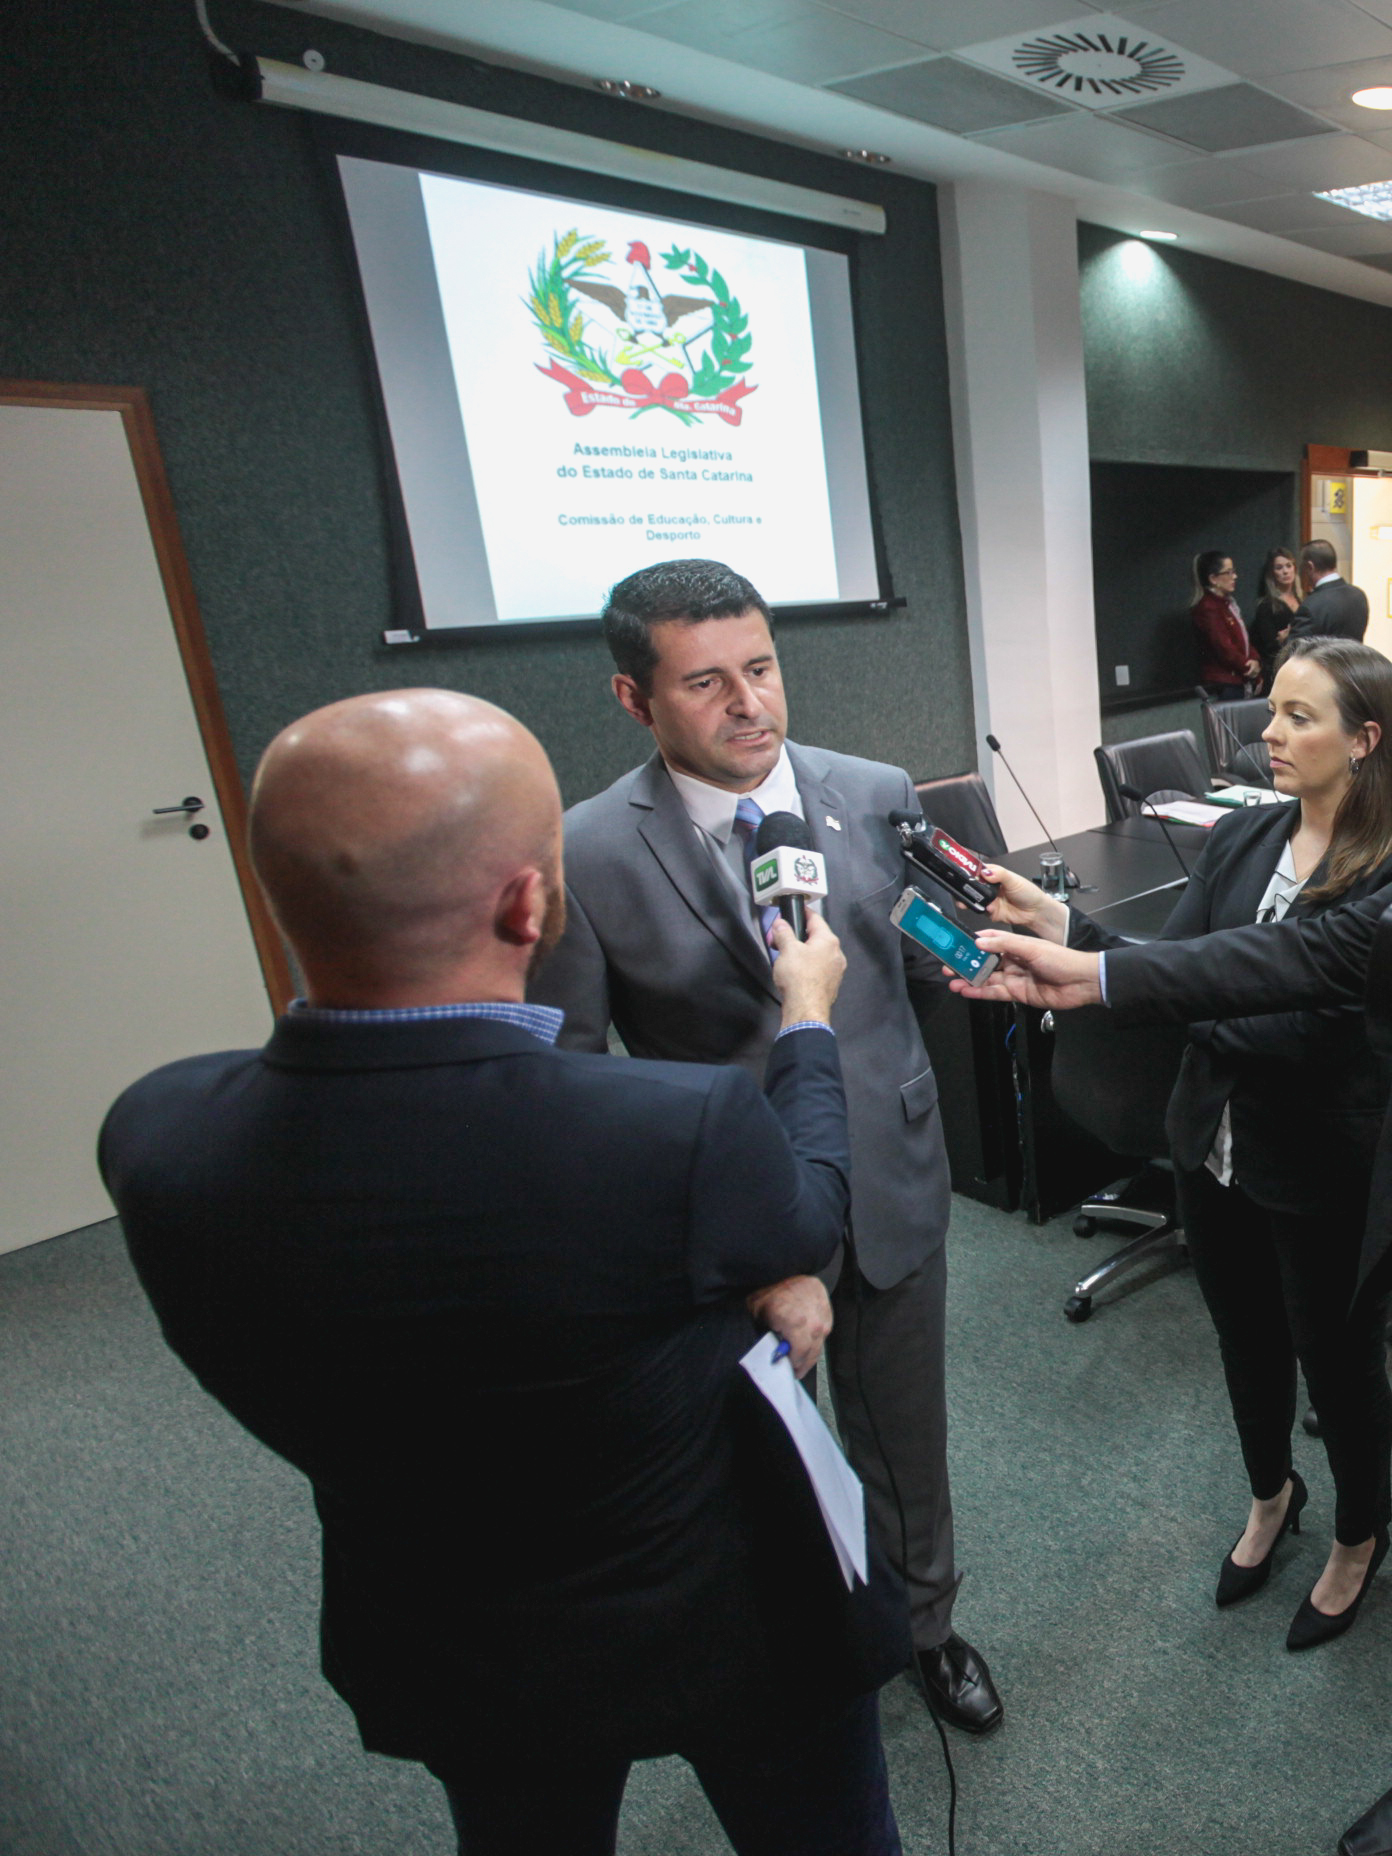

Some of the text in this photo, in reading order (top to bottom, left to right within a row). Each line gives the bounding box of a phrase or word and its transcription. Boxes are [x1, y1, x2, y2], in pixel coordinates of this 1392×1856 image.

[573, 442, 733, 462] Assembleia Legislativa
[556, 465, 754, 483] do Estado de Santa Catarina
[558, 513, 762, 527] Comissão de Educação, Cultura e
[646, 529, 701, 542] Desporto
